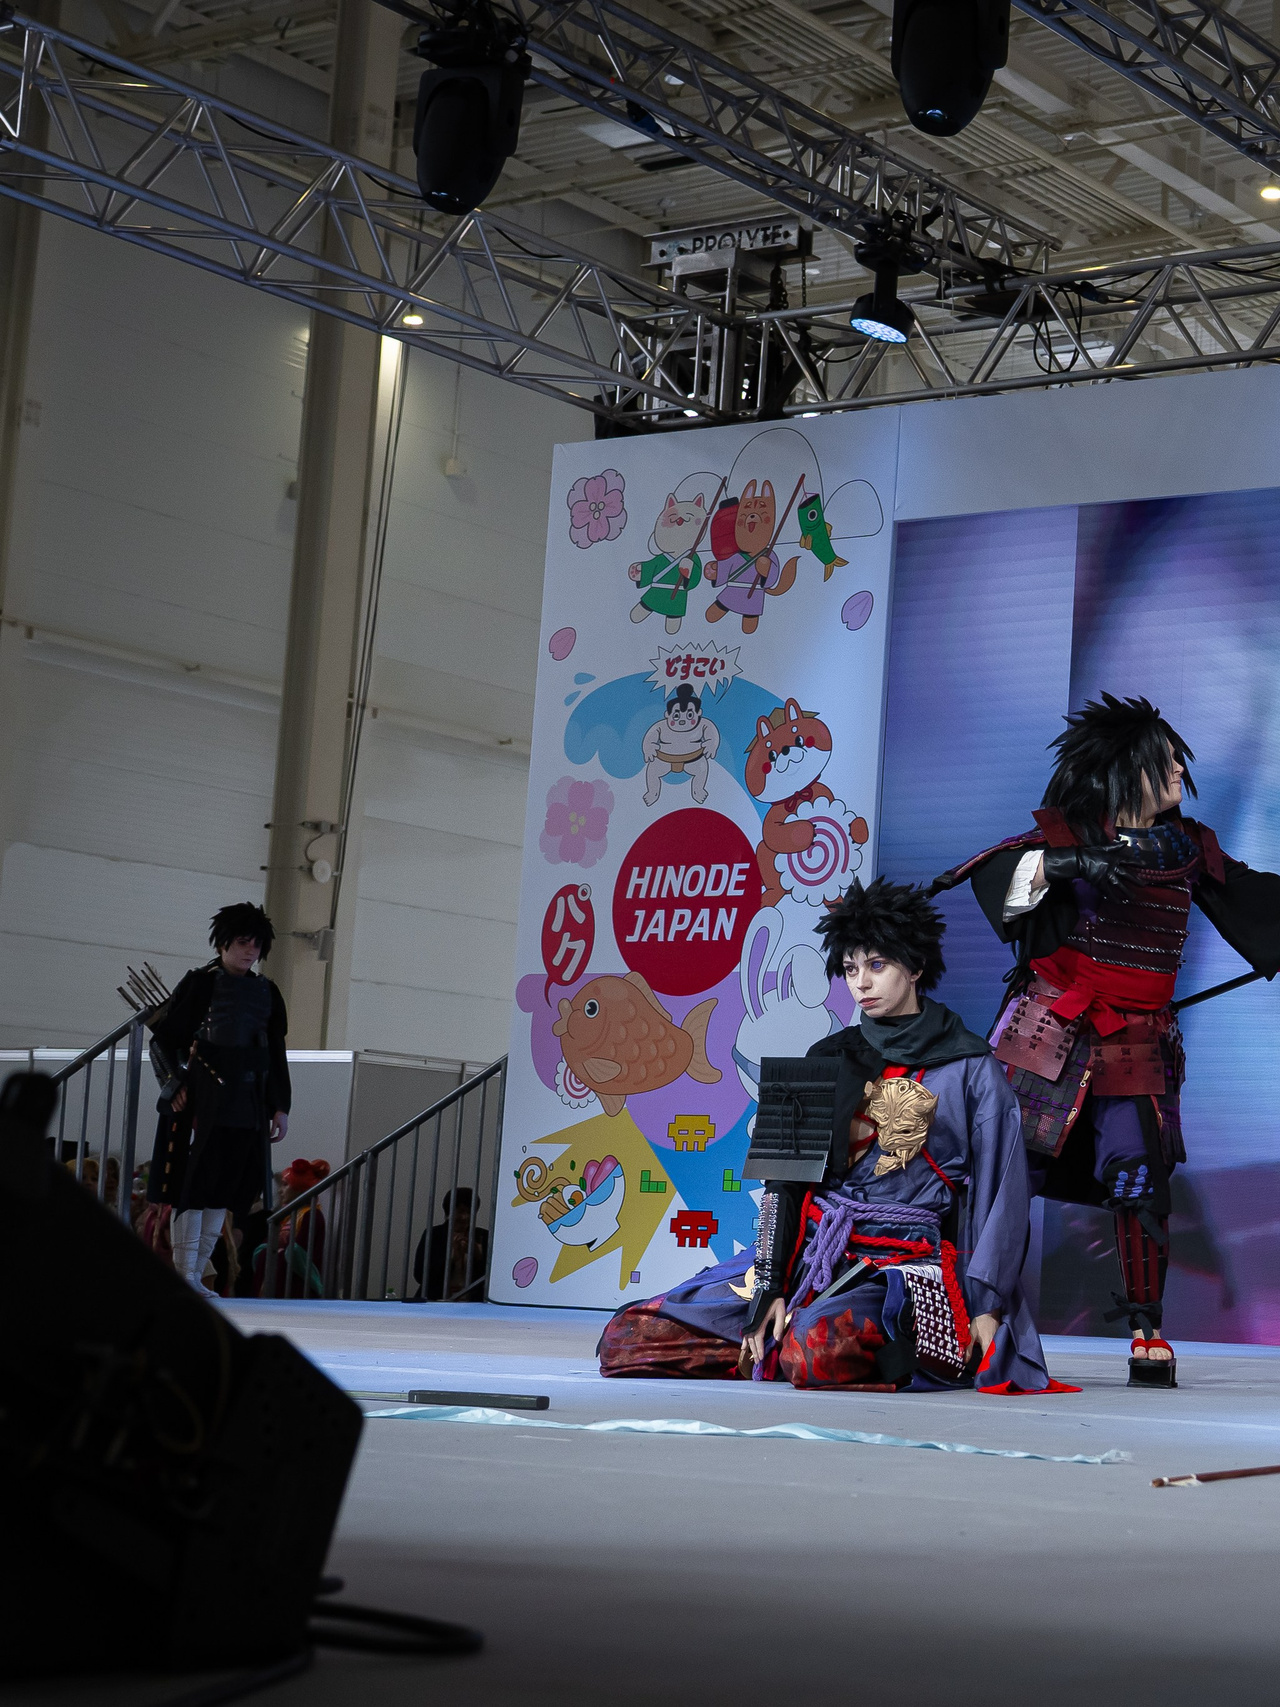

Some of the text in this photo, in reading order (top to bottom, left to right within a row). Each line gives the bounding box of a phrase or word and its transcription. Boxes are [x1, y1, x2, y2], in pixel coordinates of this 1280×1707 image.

[692, 224, 783, 253] PROLYTE
[665, 653, 726, 680] どすこい
[625, 862, 751, 899] HINODE
[551, 883, 593, 982] パク
[625, 907, 738, 943] JAPAN
